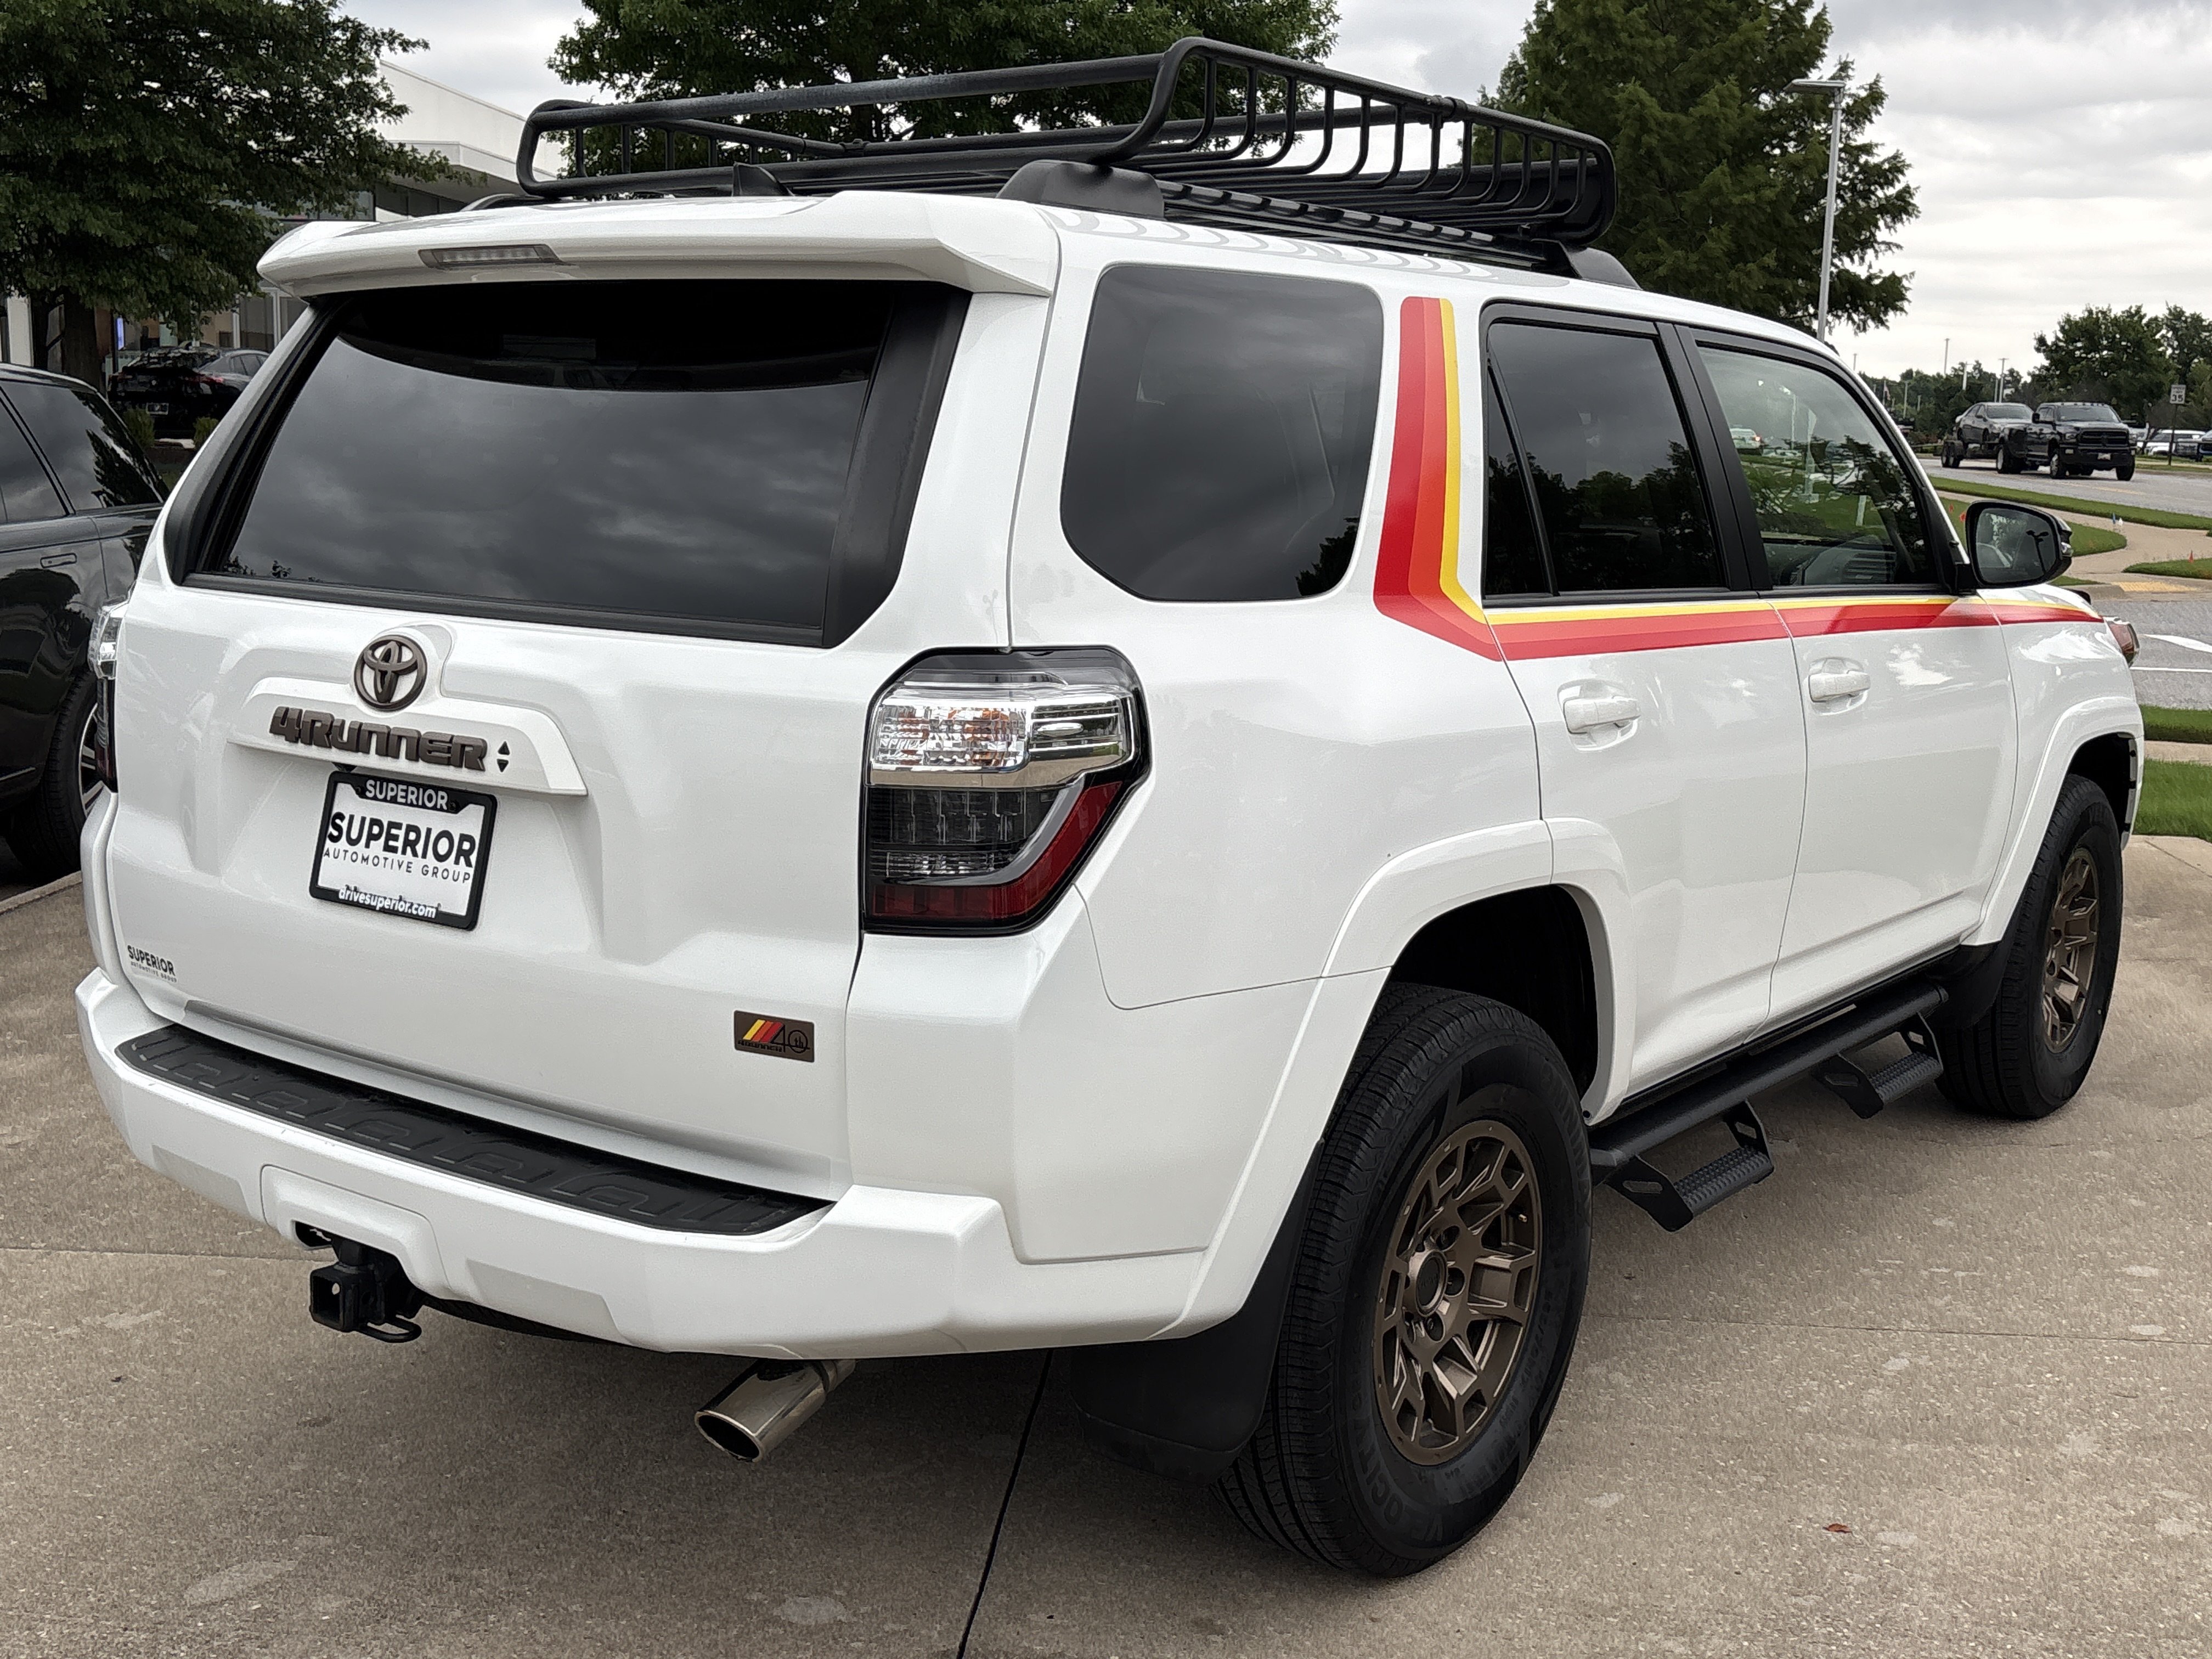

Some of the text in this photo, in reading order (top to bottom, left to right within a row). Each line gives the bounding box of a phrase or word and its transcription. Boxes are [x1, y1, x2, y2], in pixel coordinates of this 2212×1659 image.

[2171, 394, 2183, 402] 35
[269, 706, 488, 771] 4RUNNER
[365, 779, 448, 810] SUPERIOR
[328, 811, 476, 868] SUPERIOR
[323, 847, 471, 884] AUTOMOTIVE GROUP
[338, 885, 437, 918] drivesuperior.com
[127, 945, 176, 977] SUPERIOR
